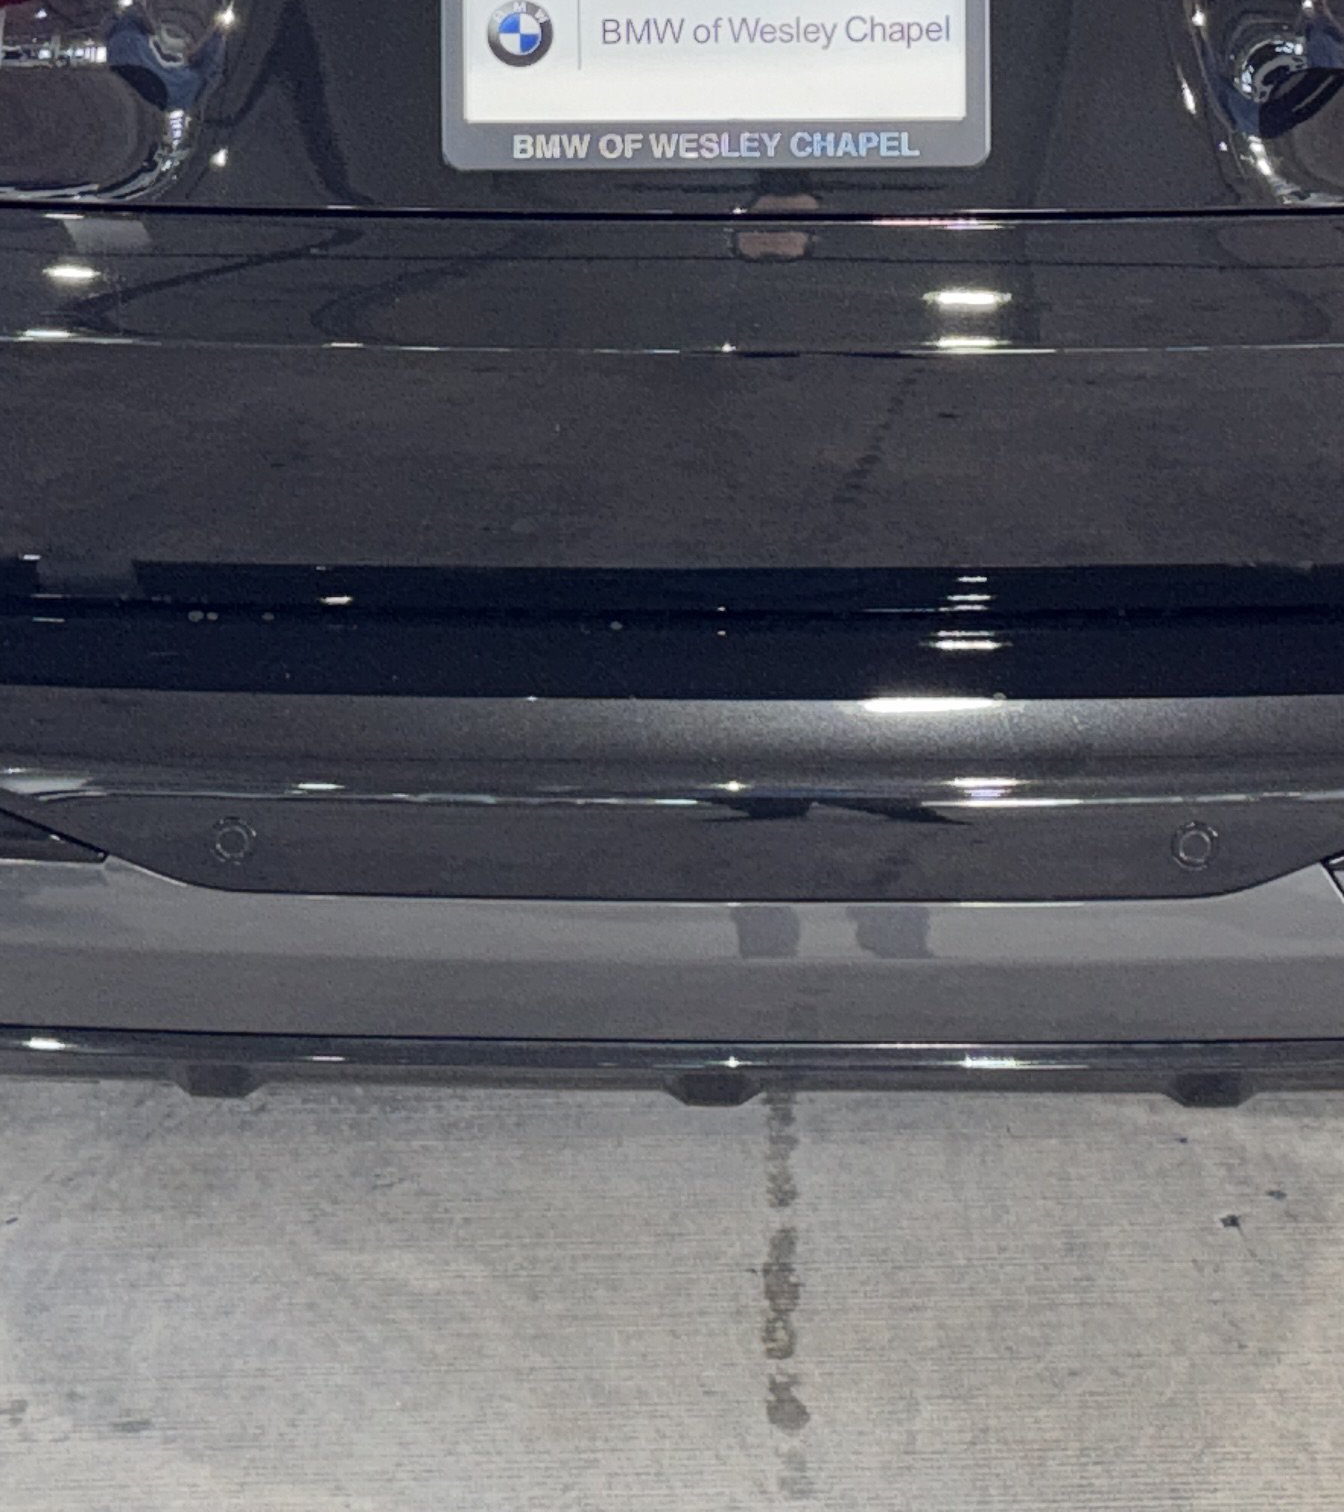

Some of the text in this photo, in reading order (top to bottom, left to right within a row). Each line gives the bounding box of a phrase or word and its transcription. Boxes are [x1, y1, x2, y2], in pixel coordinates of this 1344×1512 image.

[602, 15, 951, 50] BMW of Wesley Chapel
[512, 132, 921, 160] BMW OF WESLEY CHAPEL
